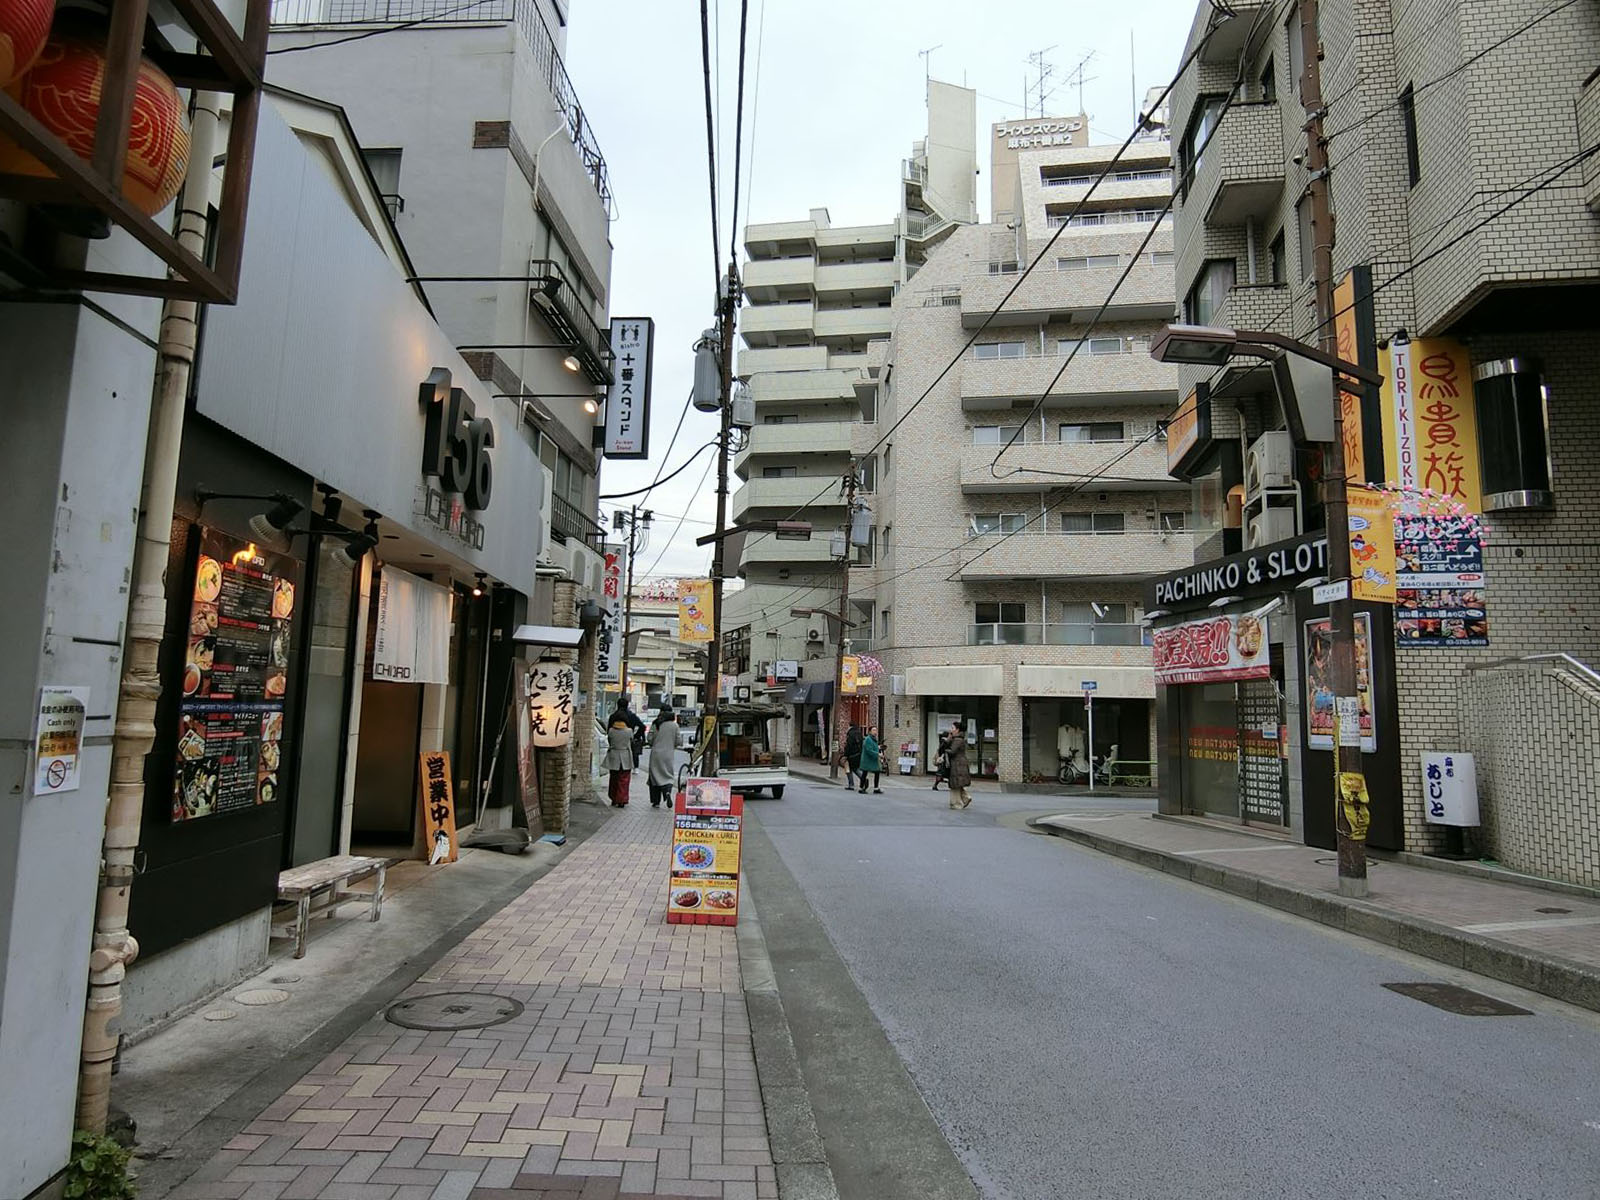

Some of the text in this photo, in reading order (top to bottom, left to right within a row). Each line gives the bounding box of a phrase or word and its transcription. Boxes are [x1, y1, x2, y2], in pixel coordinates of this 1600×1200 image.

[620, 353, 636, 436] 十番スタンド
[1418, 352, 1468, 499] 鳥貴族
[418, 367, 495, 510] 156
[1155, 539, 1328, 605] PACHINKO & SLOT
[47, 718, 76, 728] Cash only
[426, 756, 449, 827] 営業中
[716, 832, 739, 840] CURRY
